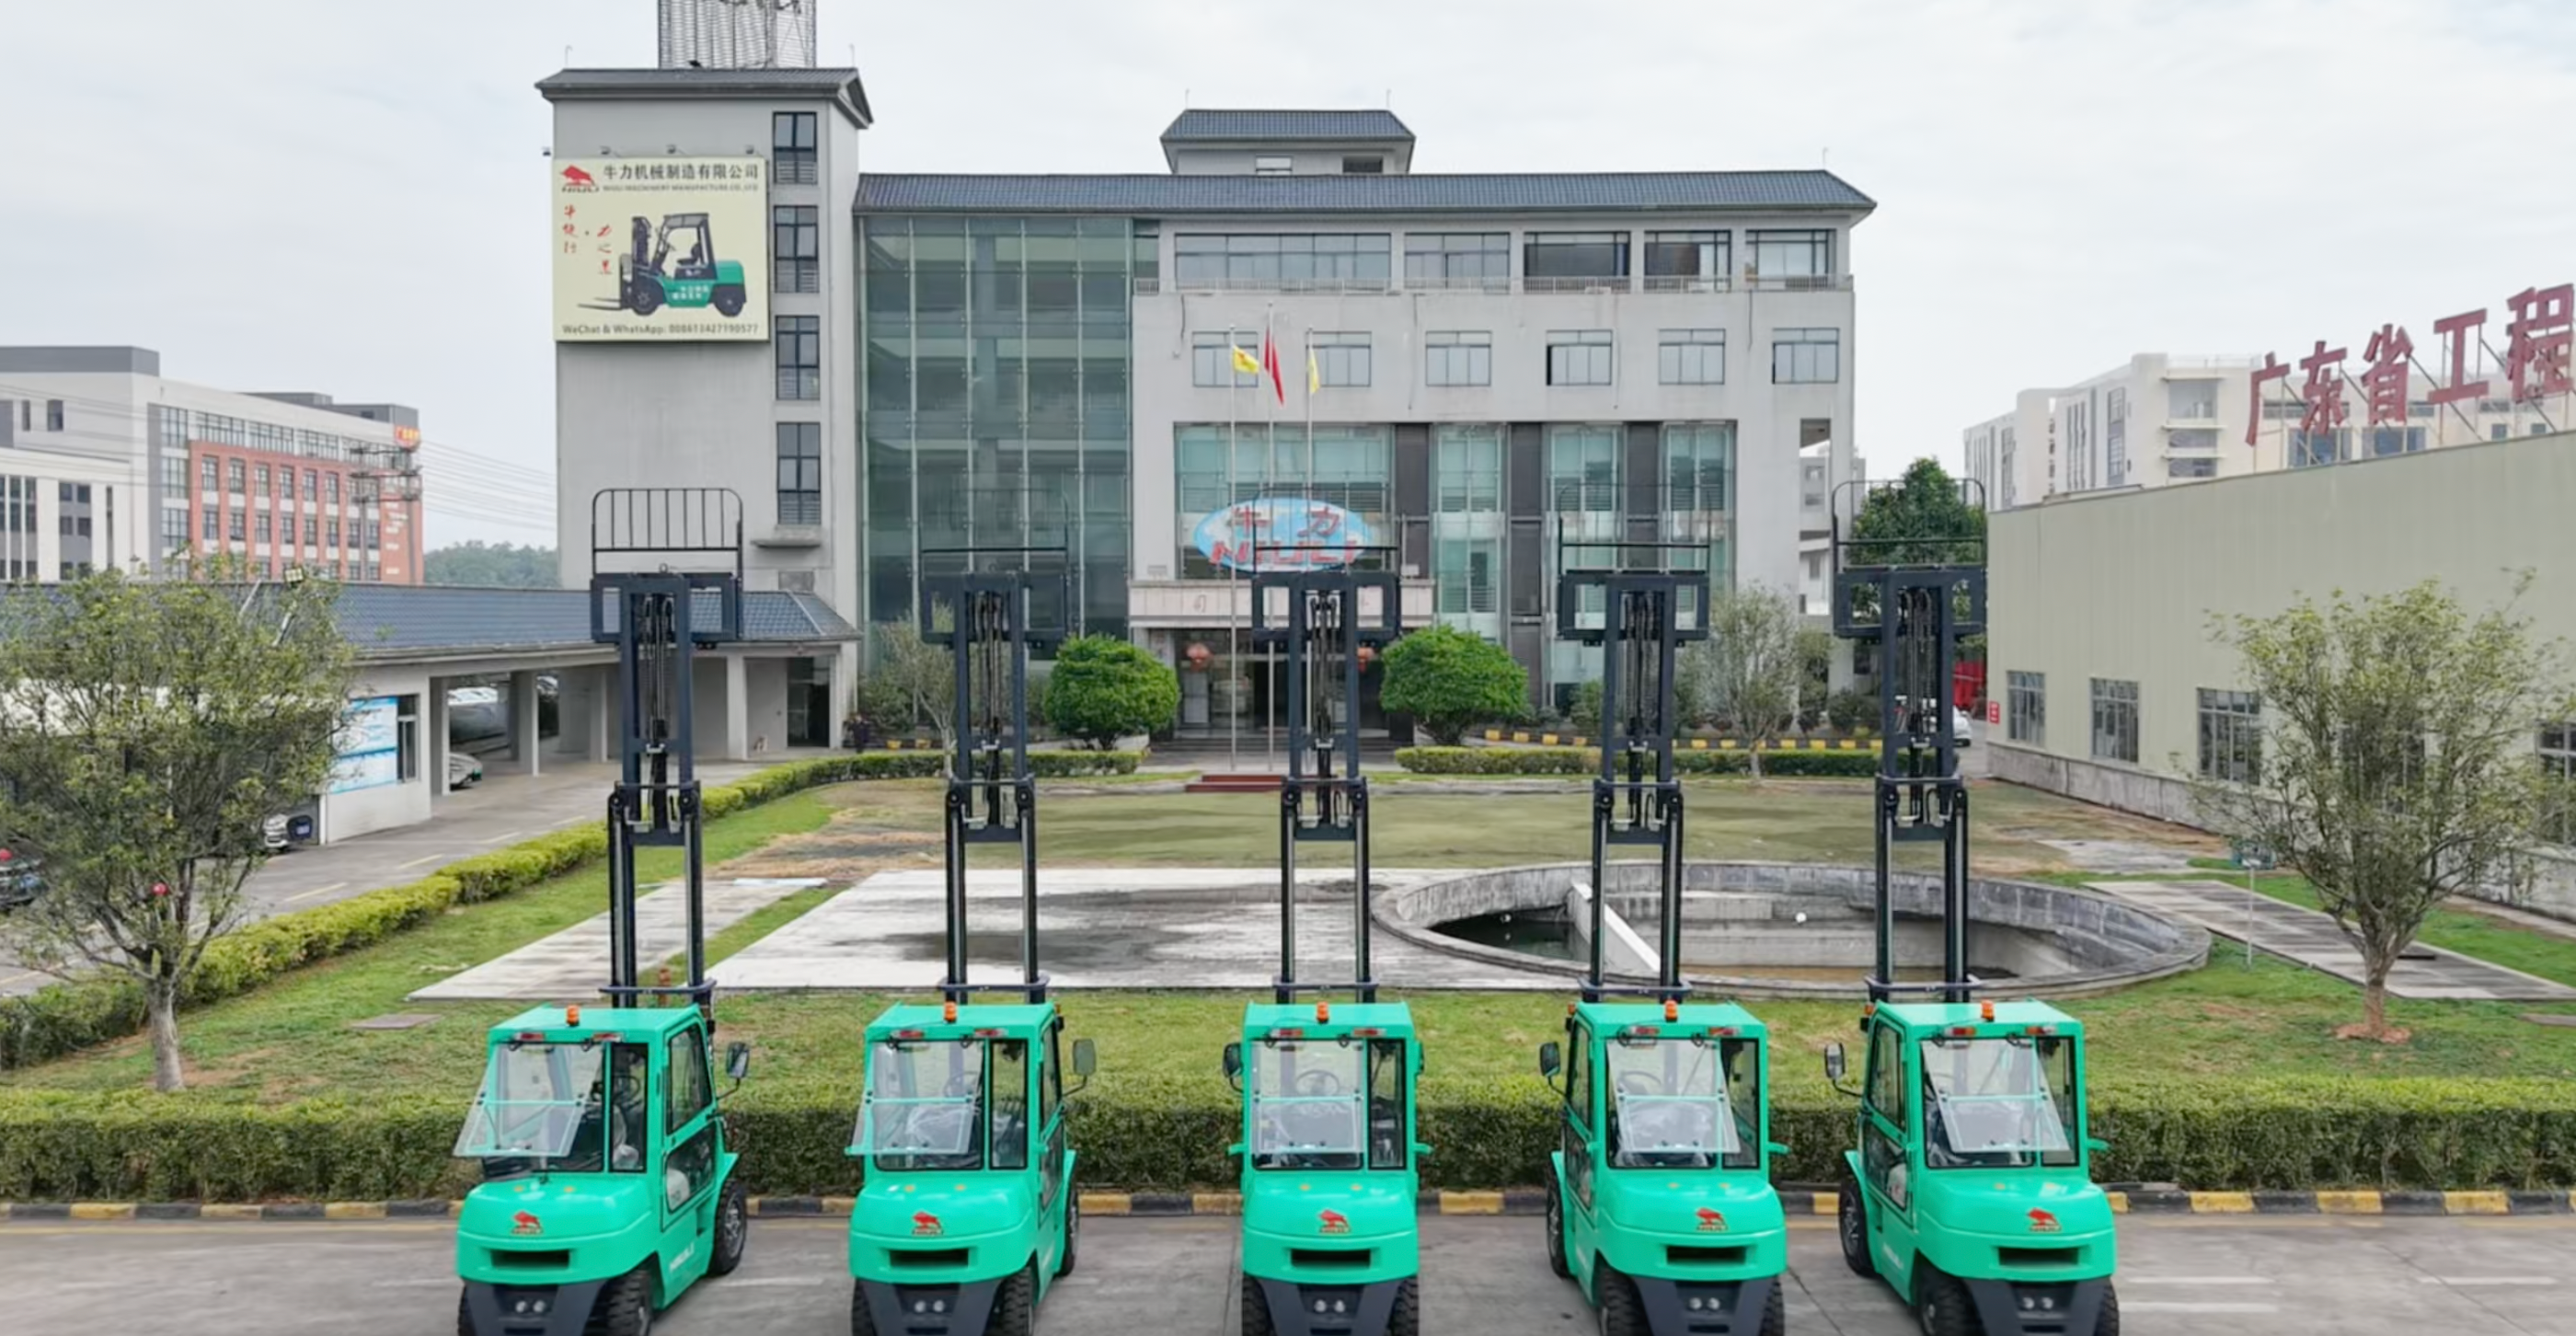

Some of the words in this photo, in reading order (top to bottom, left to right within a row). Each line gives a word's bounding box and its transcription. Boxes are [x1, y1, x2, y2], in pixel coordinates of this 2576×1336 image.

[604, 164, 759, 179] 牛力机械制造有限公司
[561, 324, 601, 335] WeChat
[603, 324, 611, 334] &
[2246, 282, 2575, 447] 广东省工程
